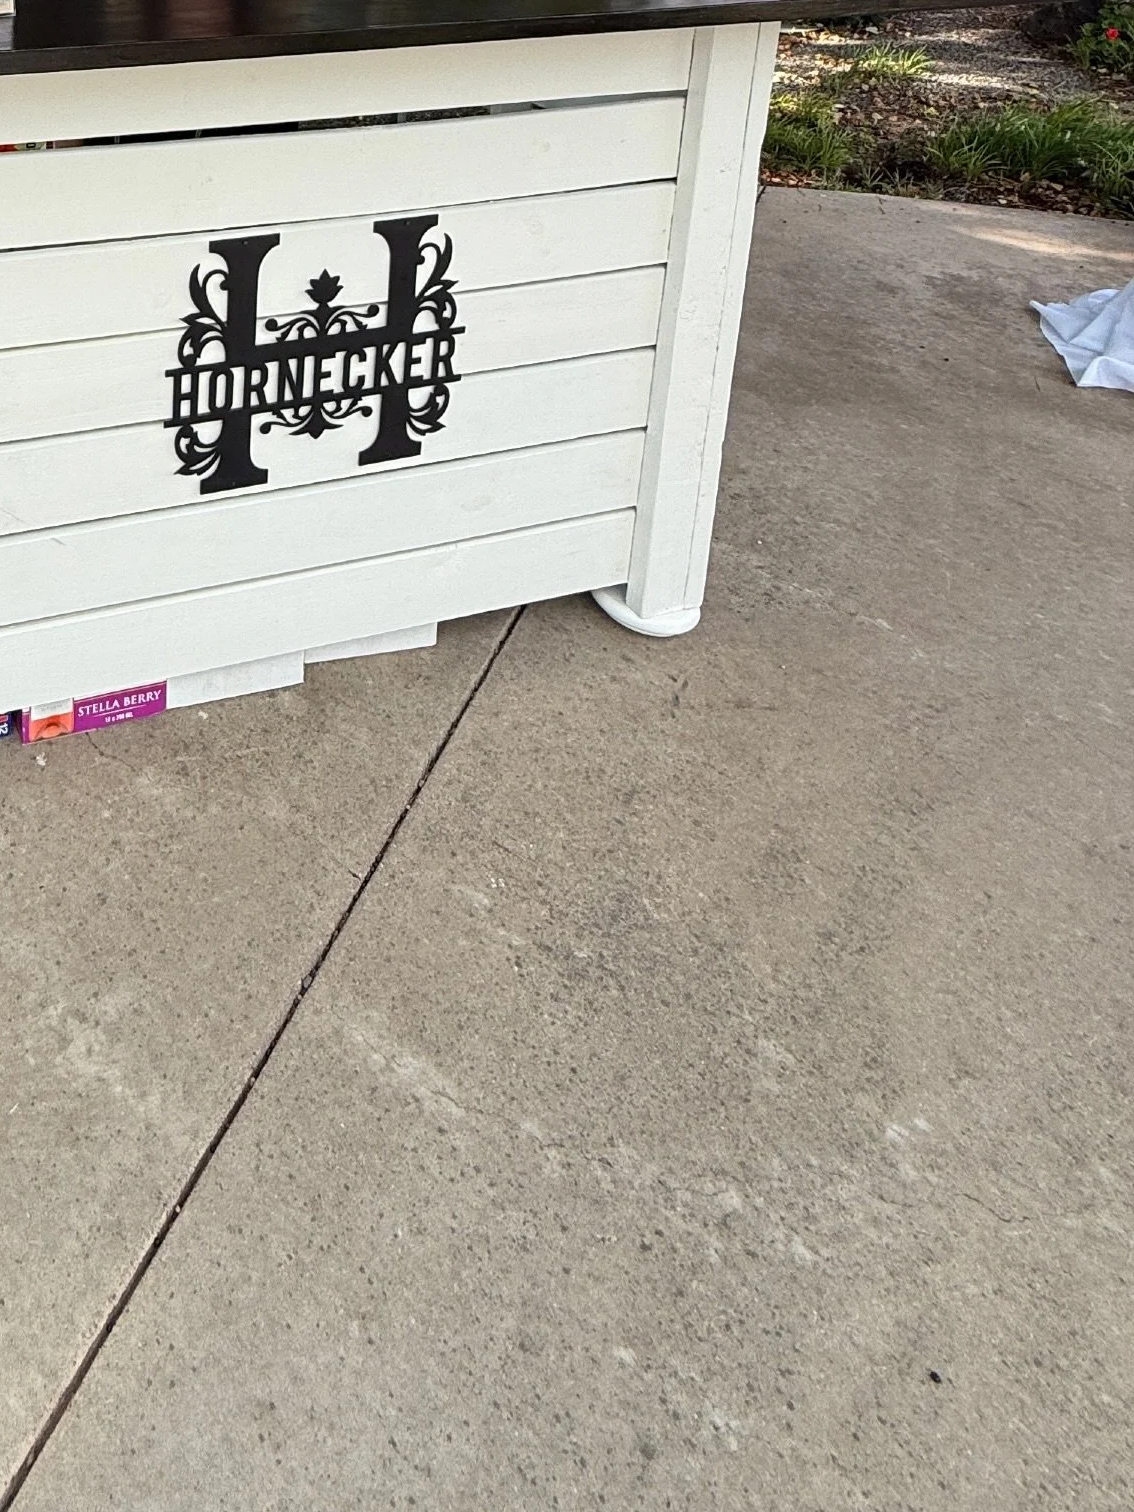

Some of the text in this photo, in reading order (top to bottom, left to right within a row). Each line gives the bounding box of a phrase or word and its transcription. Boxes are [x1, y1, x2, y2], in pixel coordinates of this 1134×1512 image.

[168, 333, 458, 423] HORNECKER
[78, 698, 120, 717] STELLA
[123, 689, 162, 707] BERRY
